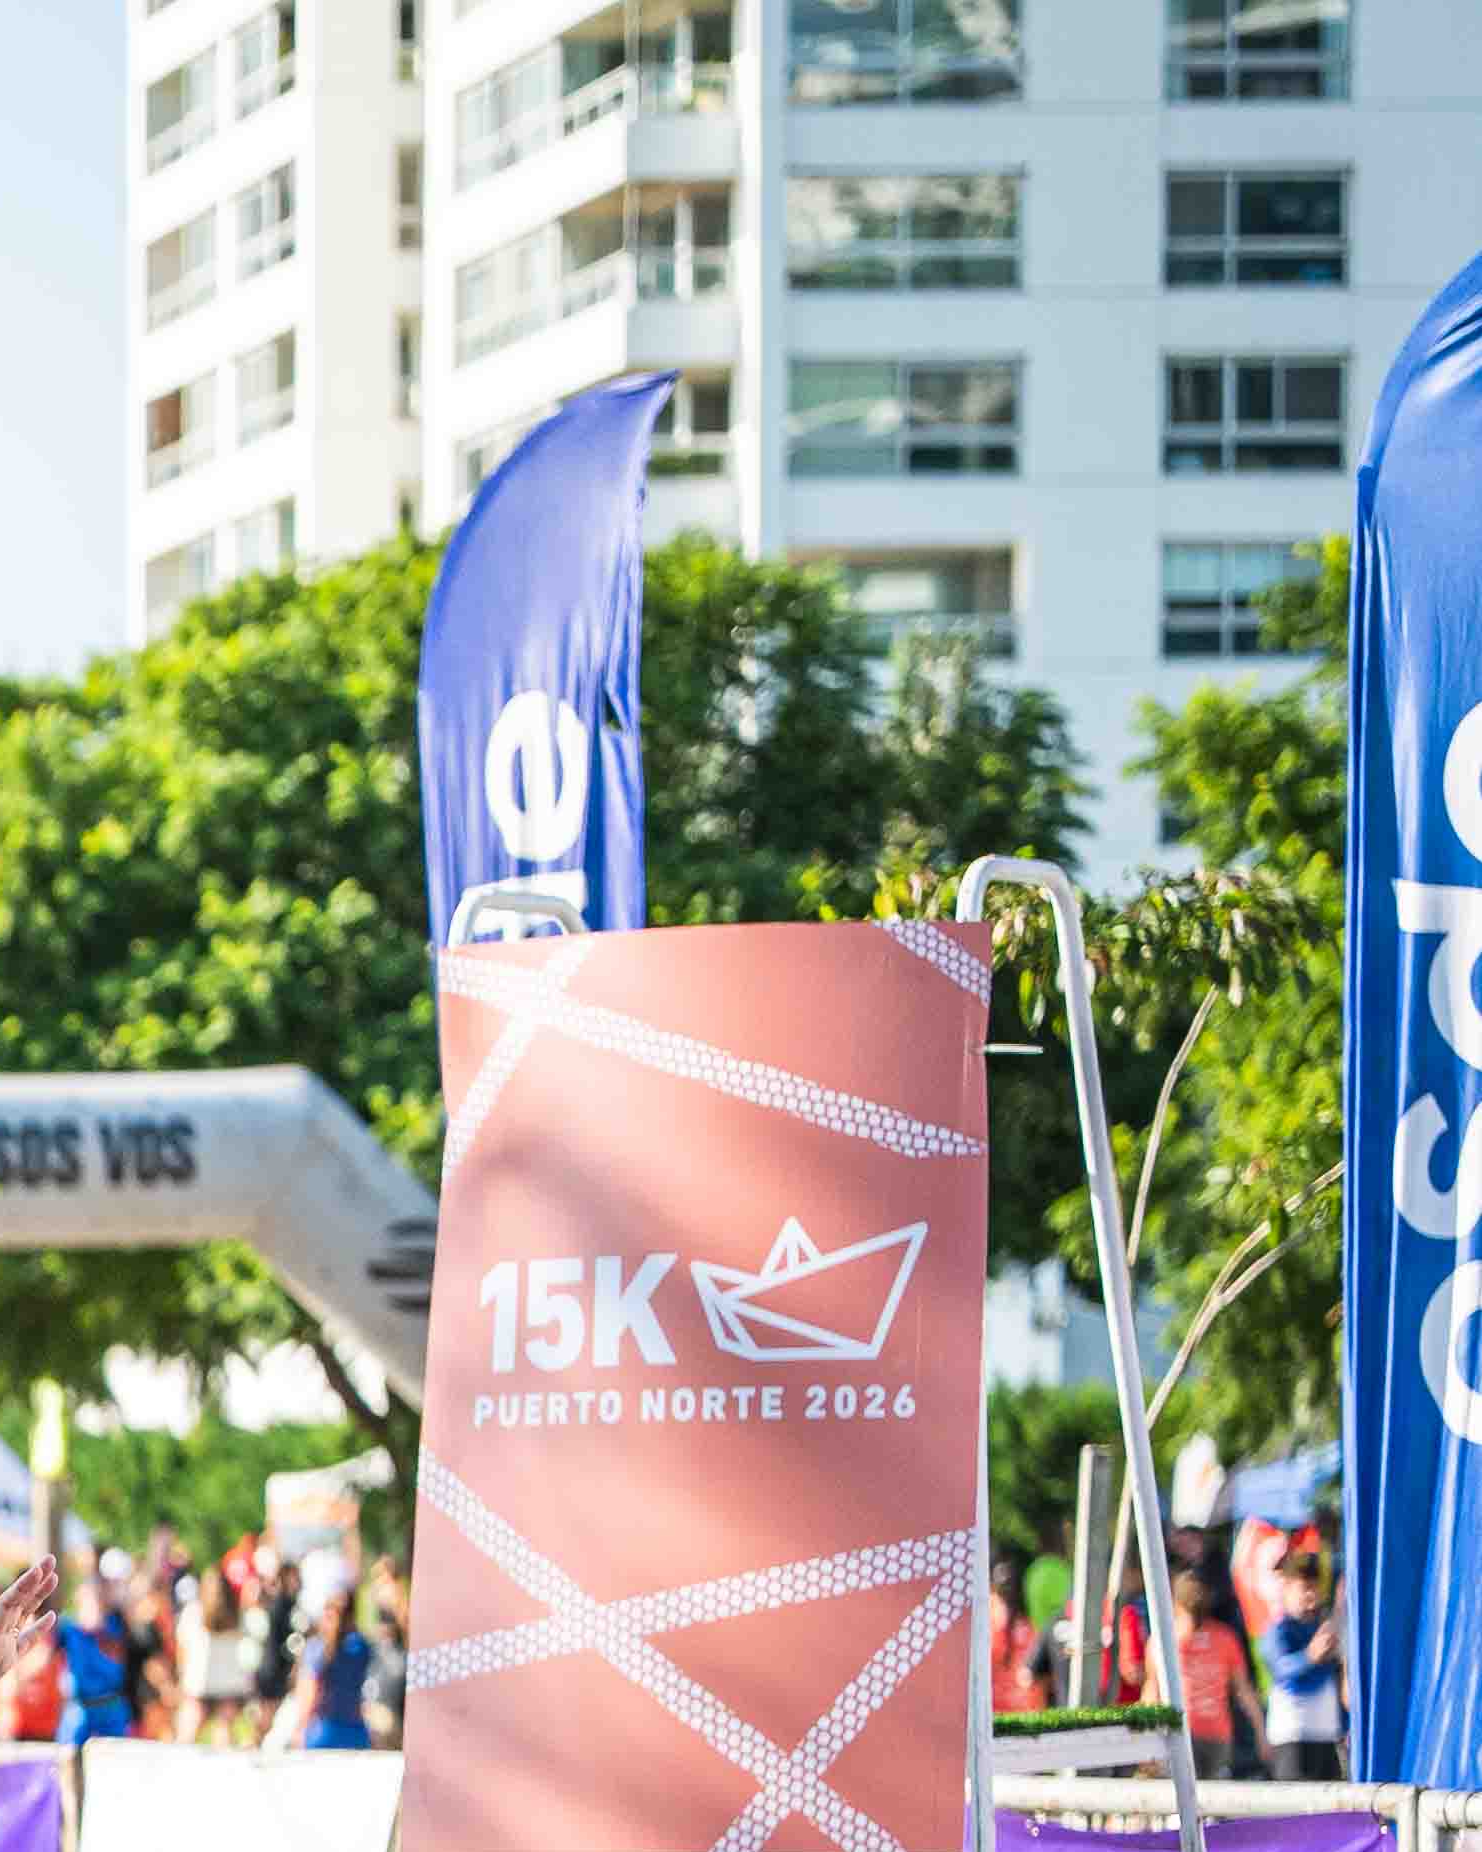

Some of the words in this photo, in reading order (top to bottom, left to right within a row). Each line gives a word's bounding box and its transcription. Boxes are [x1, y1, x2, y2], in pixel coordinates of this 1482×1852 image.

[98, 1114, 197, 1185] VOS
[477, 1253, 677, 1374] 15K
[473, 1391, 623, 1429] PUERTO
[641, 1385, 784, 1423] NORTE
[806, 1384, 916, 1420] 2026
